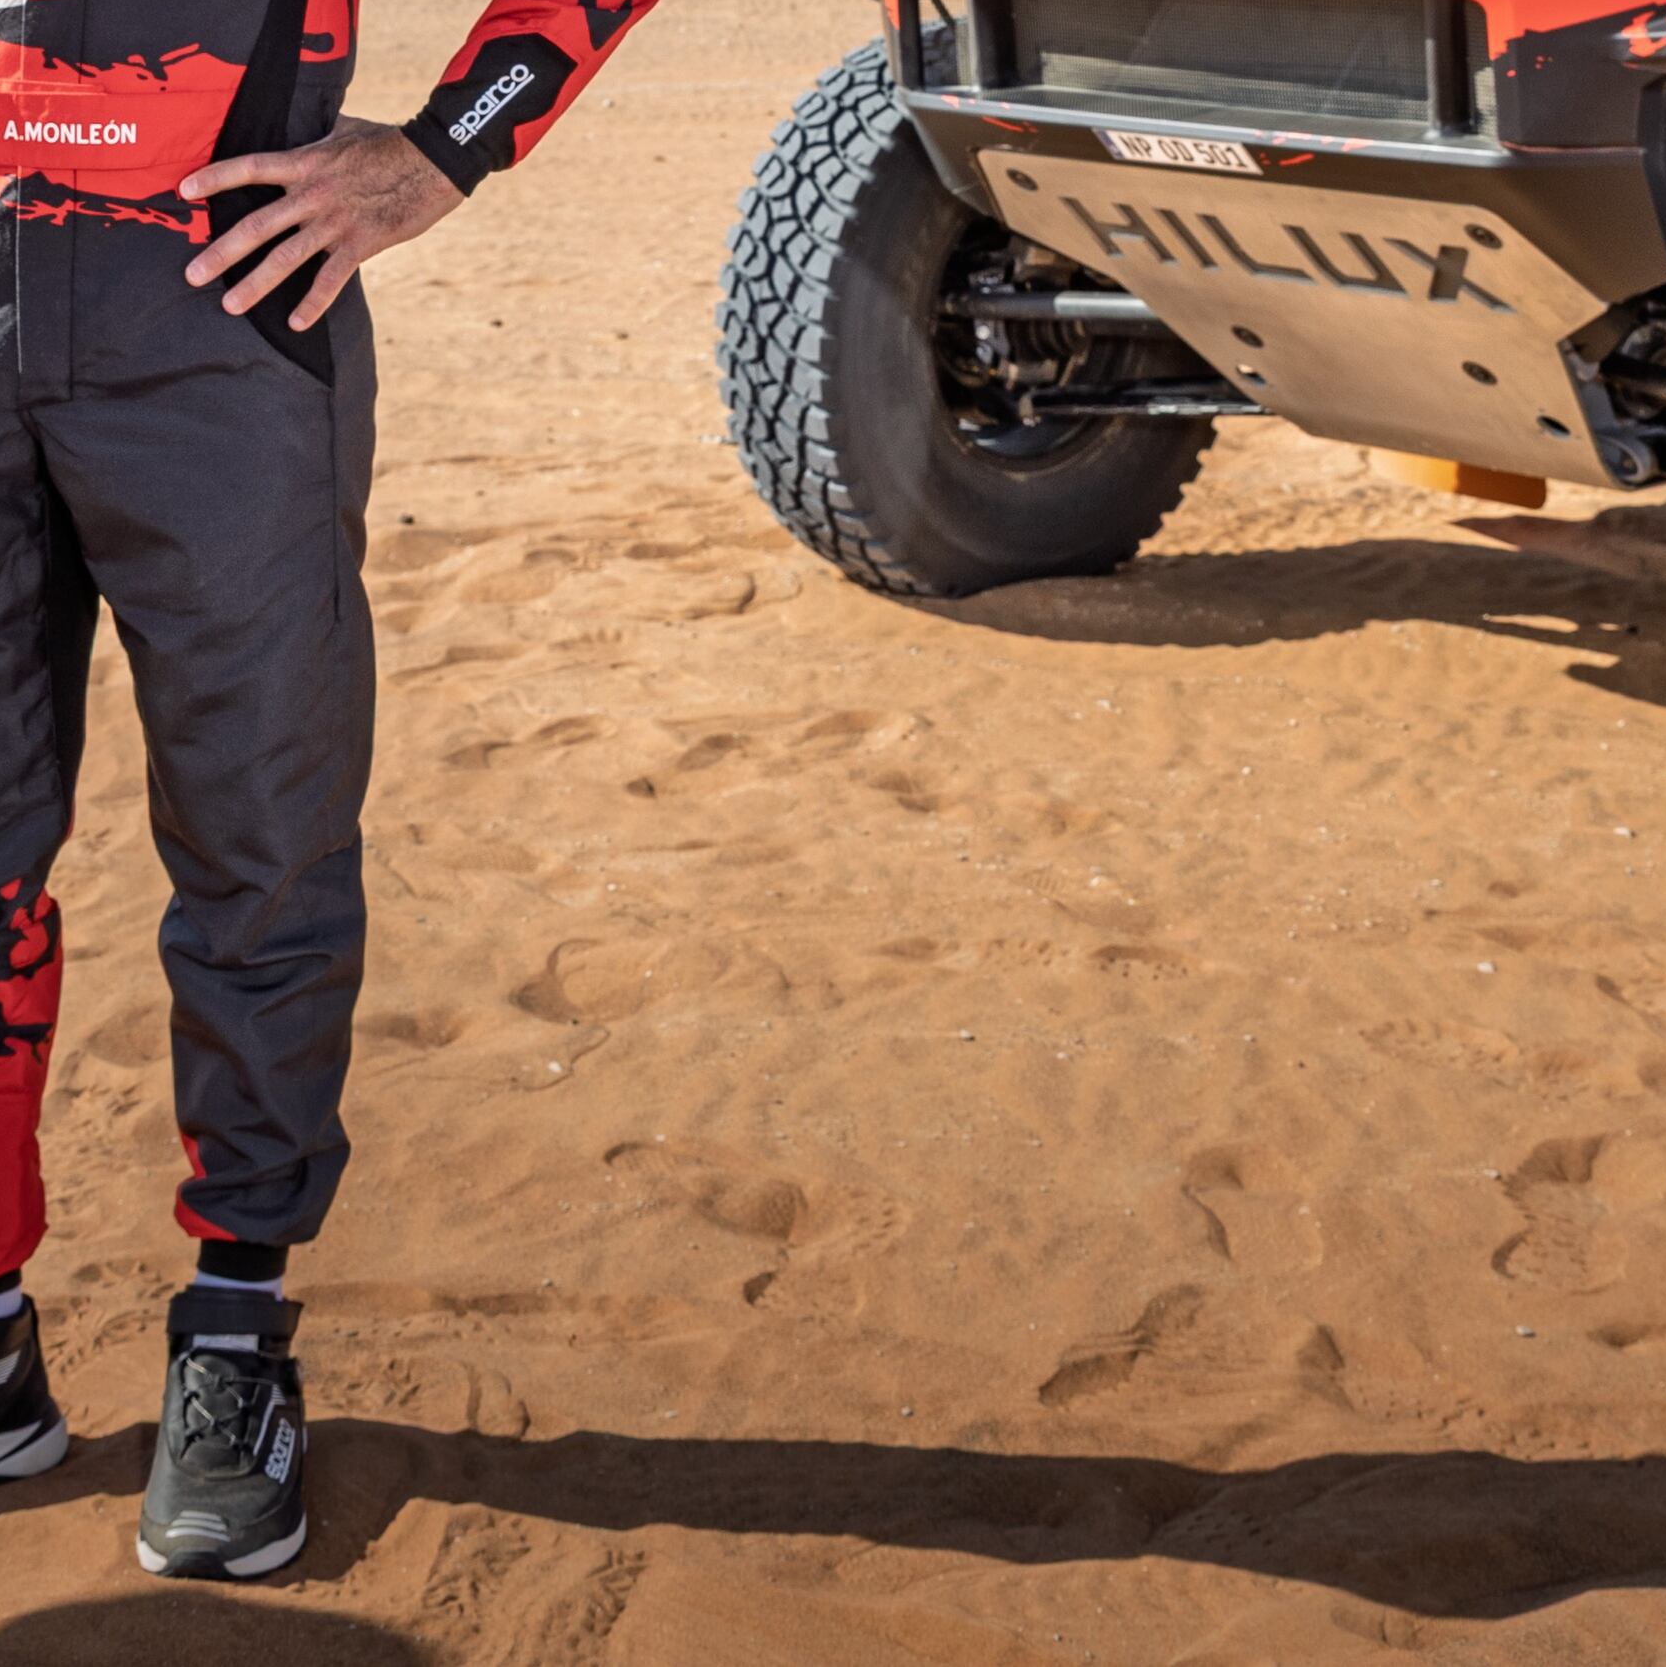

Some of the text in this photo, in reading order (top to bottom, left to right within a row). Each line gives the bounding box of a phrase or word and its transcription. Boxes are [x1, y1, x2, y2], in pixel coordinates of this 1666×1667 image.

[3, 119, 137, 145] A.MONLEÓN
[448, 64, 535, 146] sparco
[1119, 135, 1153, 159] NP
[1192, 142, 1249, 168] 501
[1059, 195, 1517, 315] HILUX
